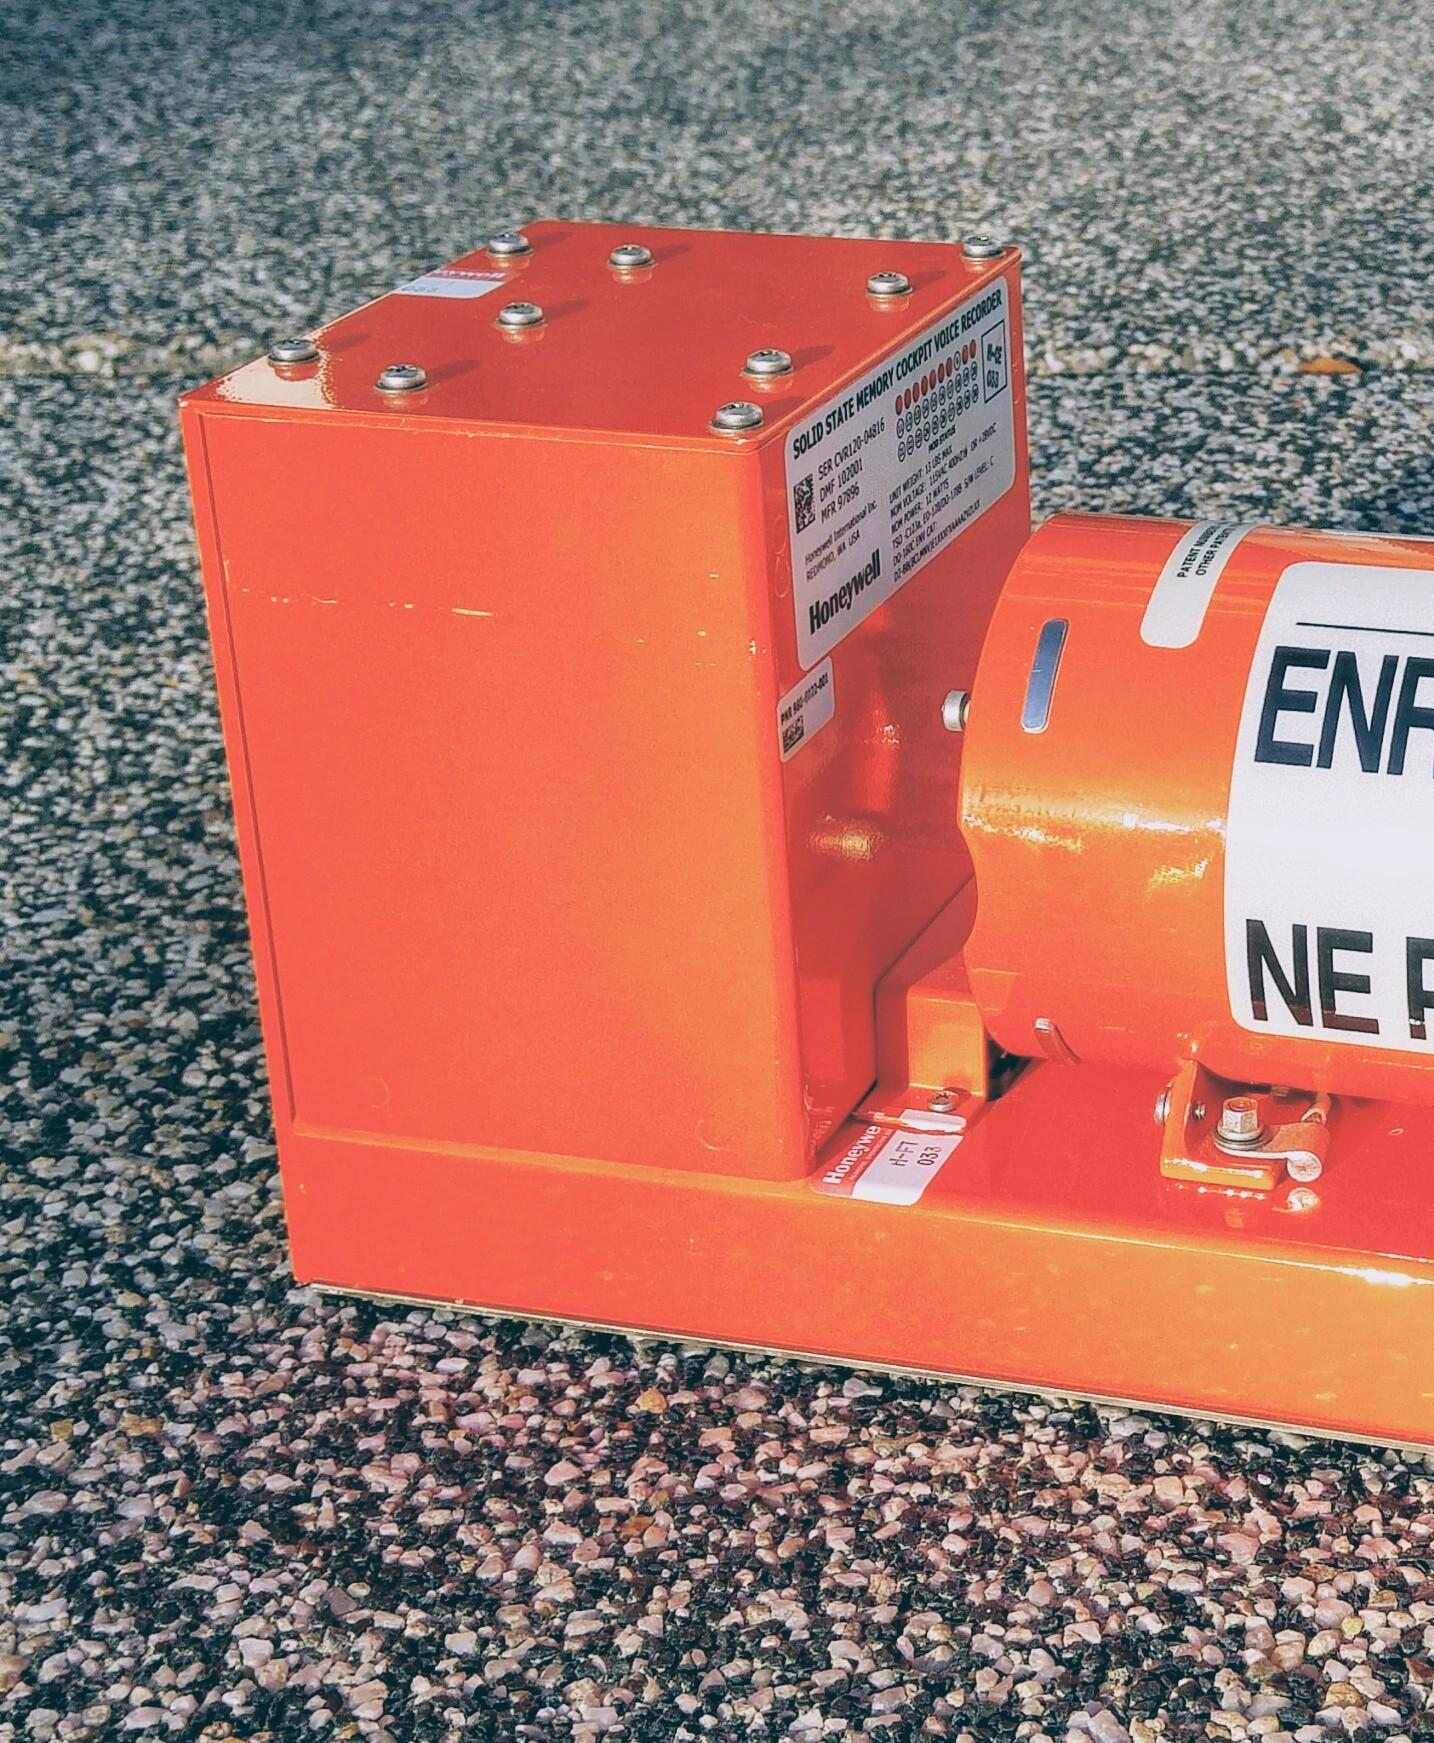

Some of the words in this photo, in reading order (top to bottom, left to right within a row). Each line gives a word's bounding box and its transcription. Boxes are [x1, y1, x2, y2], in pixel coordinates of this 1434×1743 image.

[793, 422, 823, 459] SOLID
[825, 397, 854, 435] STATE
[856, 368, 893, 411] MEMORY
[896, 339, 932, 381] COCKPIT
[934, 319, 959, 352] VOICE
[961, 289, 1002, 333] RECORDER
[818, 458, 833, 480] SER
[834, 417, 885, 467] CVR120-04816
[820, 478, 835, 502] DMF
[838, 458, 863, 488] 102001
[821, 500, 836, 523] MFR
[834, 506, 867, 541] International
[848, 529, 860, 546] USA
[1176, 547, 1201, 578] PATENT
[1195, 549, 1217, 576] OTHER
[809, 549, 880, 634] Honeywell
[1244, 919, 1380, 1036] NE
[822, 1125, 881, 1184] Honeywe
[916, 1147, 943, 1166] 033
